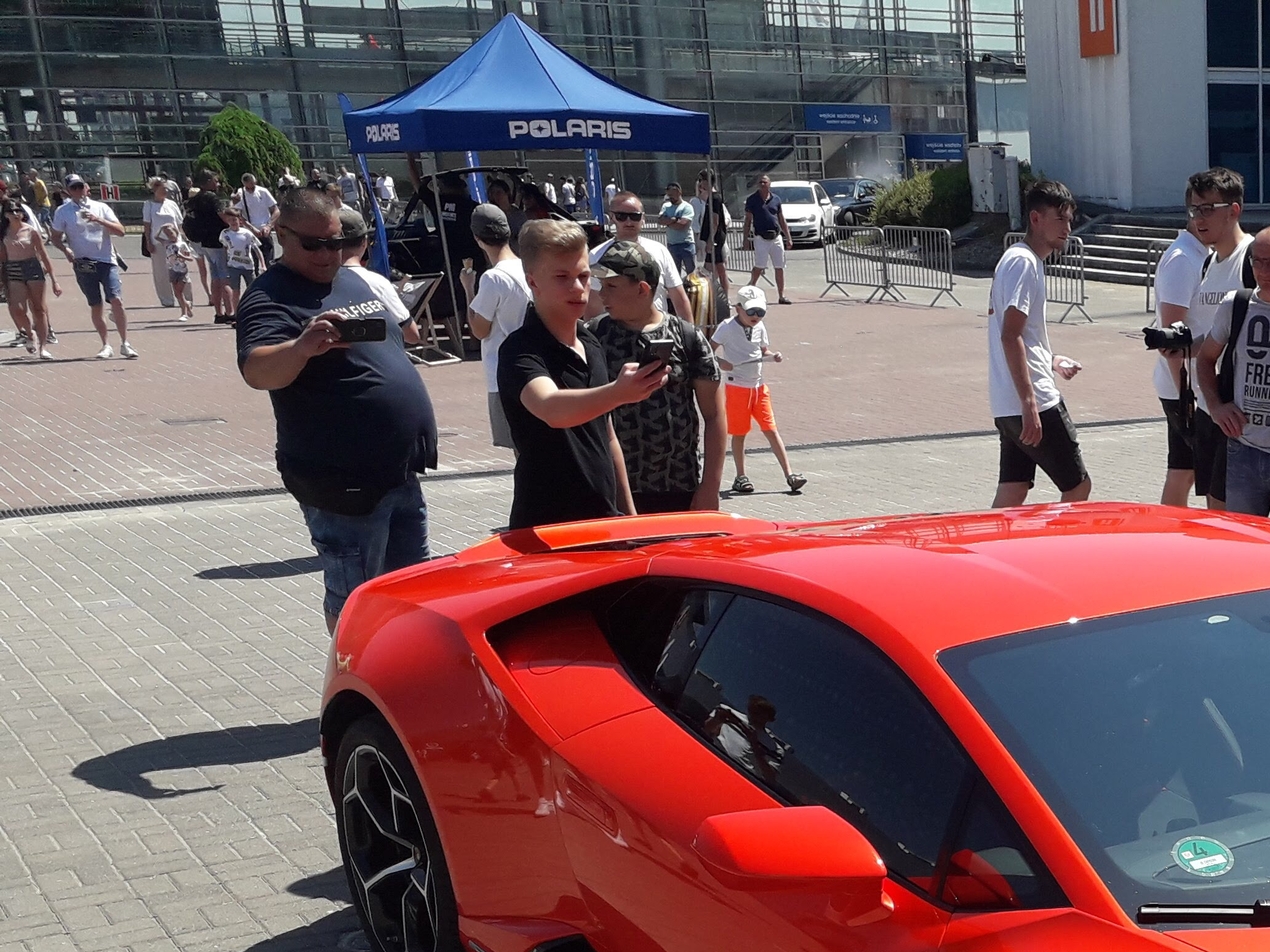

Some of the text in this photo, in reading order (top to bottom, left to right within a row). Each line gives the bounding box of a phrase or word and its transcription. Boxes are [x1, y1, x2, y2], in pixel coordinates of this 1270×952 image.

[366, 123, 400, 143] POLARIS
[508, 119, 632, 140] POLARIS
[1192, 842, 1208, 855] 4
